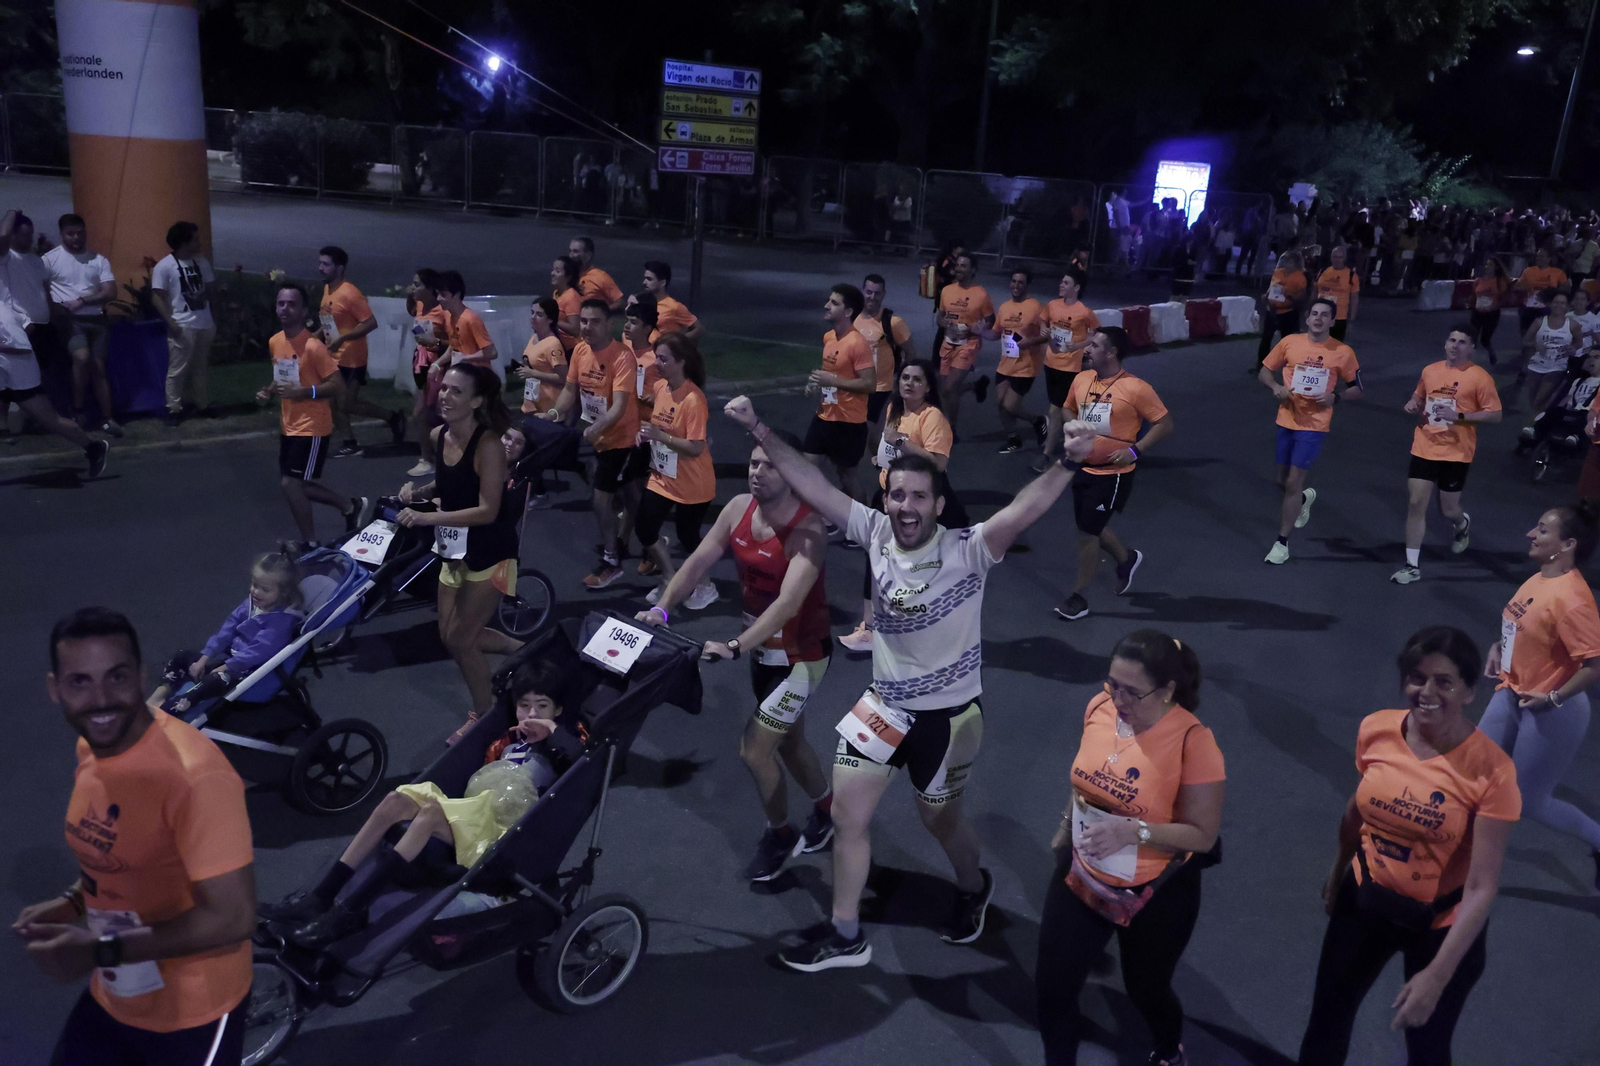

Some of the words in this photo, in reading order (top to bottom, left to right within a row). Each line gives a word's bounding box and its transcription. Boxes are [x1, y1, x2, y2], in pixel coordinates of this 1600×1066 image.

[667, 63, 694, 72] hospital
[667, 71, 693, 82] Virgen
[695, 75, 708, 84] del
[696, 94, 718, 105] Prado
[665, 102, 681, 111] San
[691, 132, 712, 142] Plaza
[715, 134, 726, 143] de
[729, 135, 755, 145] Armas
[702, 151, 725, 161] Caixa
[728, 152, 752, 163] Forum
[701, 161, 722, 171] Torre
[725, 162, 752, 173] Sevilla
[1302, 375, 1320, 385] 7303
[356, 532, 385, 546] 19493
[891, 597, 905, 607] DE
[608, 626, 640, 649] 19496
[780, 696, 791, 705] DE
[865, 712, 890, 736] 1227
[1073, 766, 1109, 793] SEVILLA
[1092, 769, 1139, 796] NOCTURNA
[1369, 796, 1413, 821] SEVILLA
[1392, 796, 1446, 821] NOCTURNA
